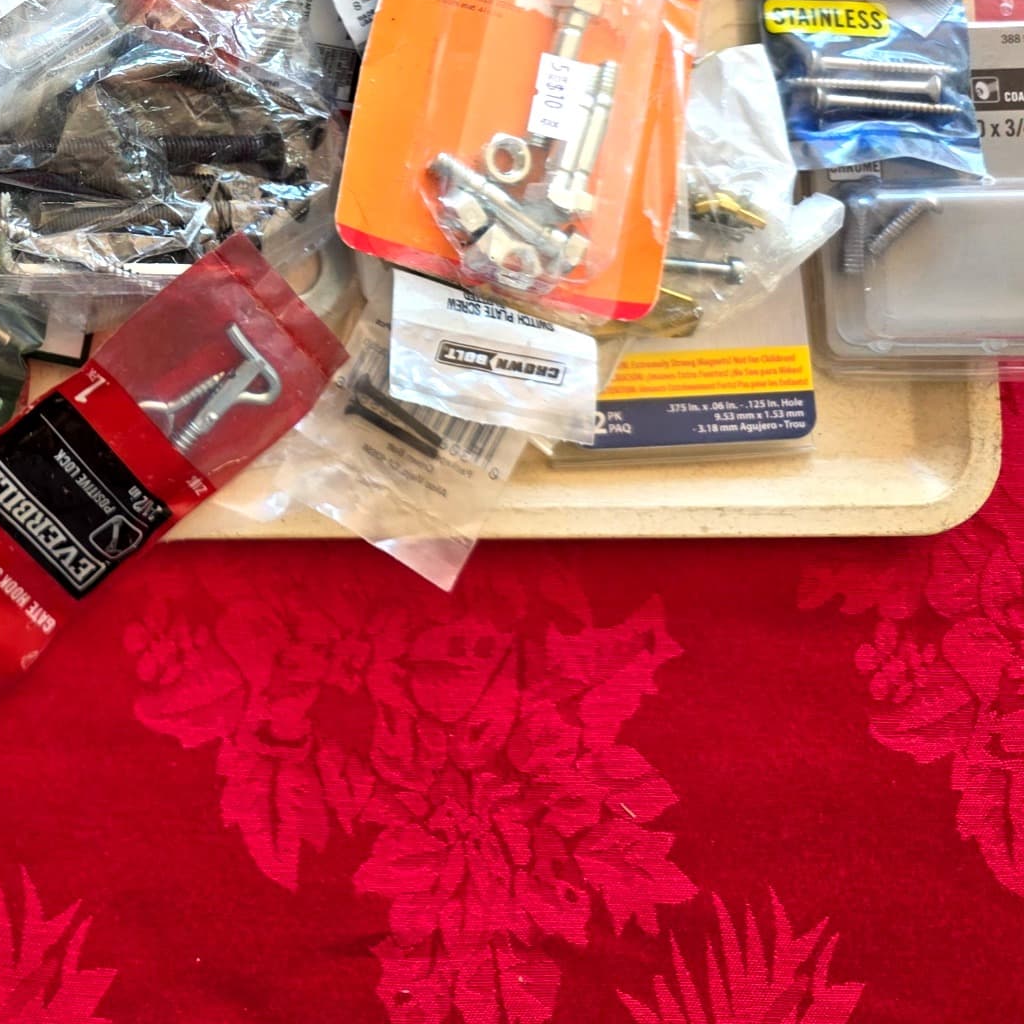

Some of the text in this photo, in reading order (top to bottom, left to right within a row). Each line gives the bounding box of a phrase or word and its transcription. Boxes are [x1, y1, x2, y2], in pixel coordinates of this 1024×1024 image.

[772, 7, 883, 30] STAINLESS
[1000, 34, 1021, 44] 388
[445, 297, 555, 331] SWITCH PLATE SCREW
[444, 346, 560, 379] CROWN BOLT
[697, 419, 805, 434] 3.18 mm Agujero Trou
[714, 408, 804, 422] 9.53 mm x 1.53 mm
[608, 423, 632, 435] PAQ
[50, 447, 118, 516] POSITIVE LOCK
[23, 599, 58, 634] GATE
